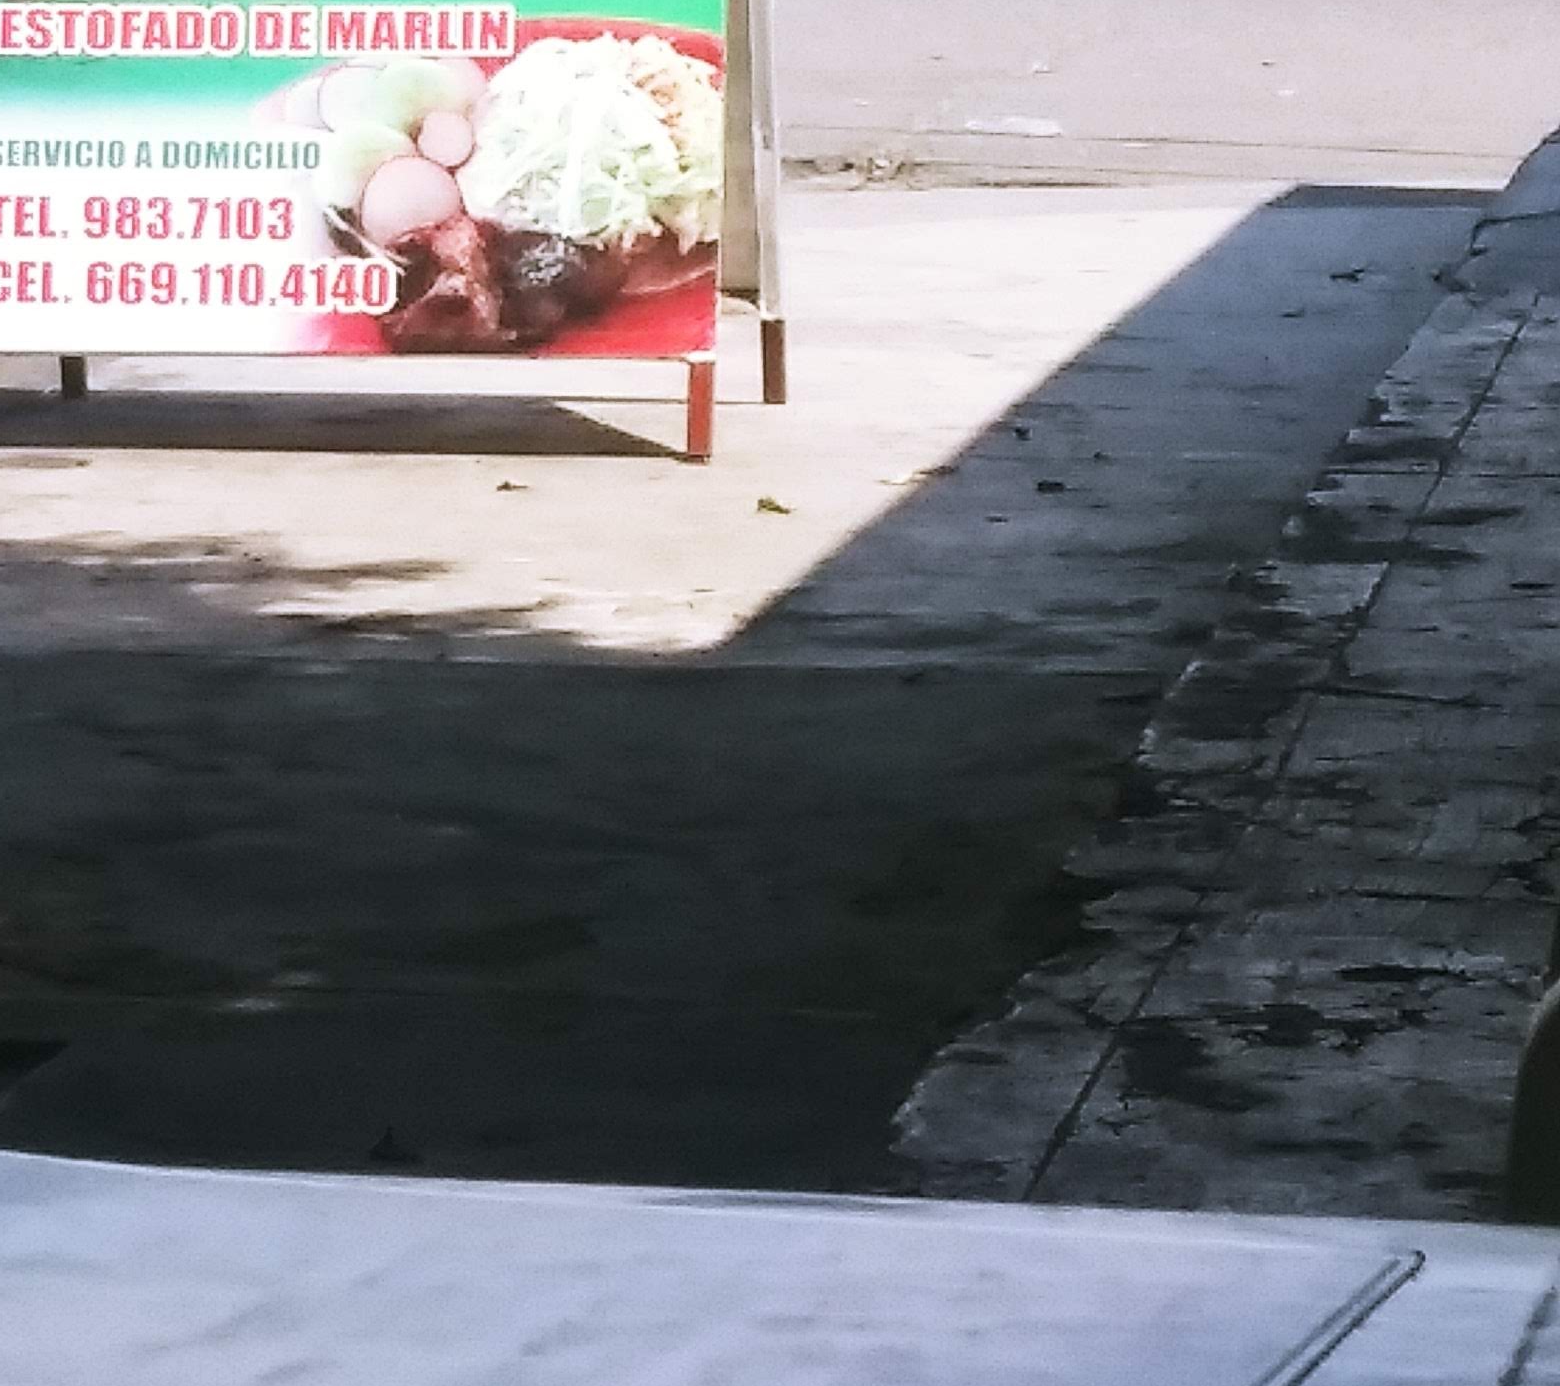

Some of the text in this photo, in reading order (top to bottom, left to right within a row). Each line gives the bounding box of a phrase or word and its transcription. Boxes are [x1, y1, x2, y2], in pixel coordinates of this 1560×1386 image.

[0, 9, 509, 52] ESTOFADO DE MARLIN
[134, 141, 153, 169] A
[162, 140, 321, 170] DOMICILIO
[83, 195, 295, 240] 983.7103
[85, 261, 391, 307] 669.110.4140
